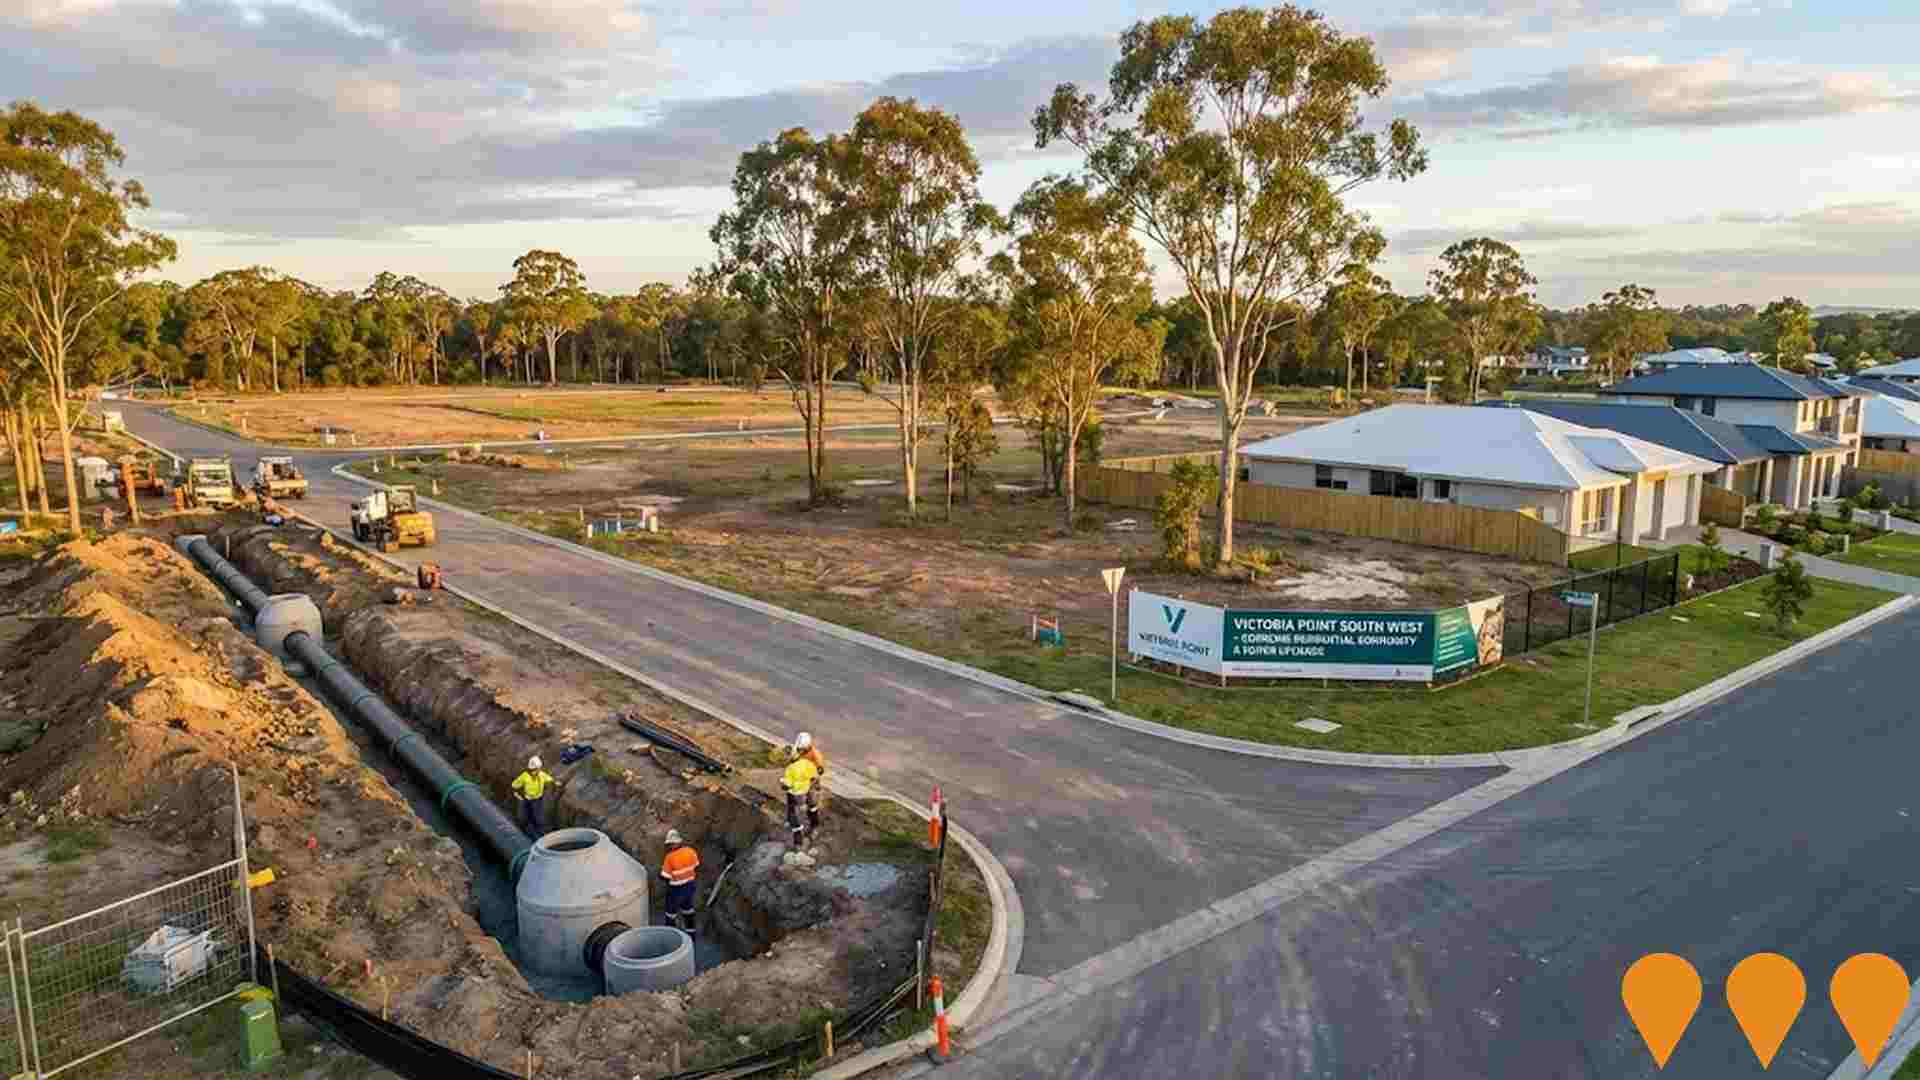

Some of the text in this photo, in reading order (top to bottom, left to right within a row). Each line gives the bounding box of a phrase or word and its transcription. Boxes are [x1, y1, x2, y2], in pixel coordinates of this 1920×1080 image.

[1233, 618, 1424, 633] VICTORIA POINT SOUTH WEST
